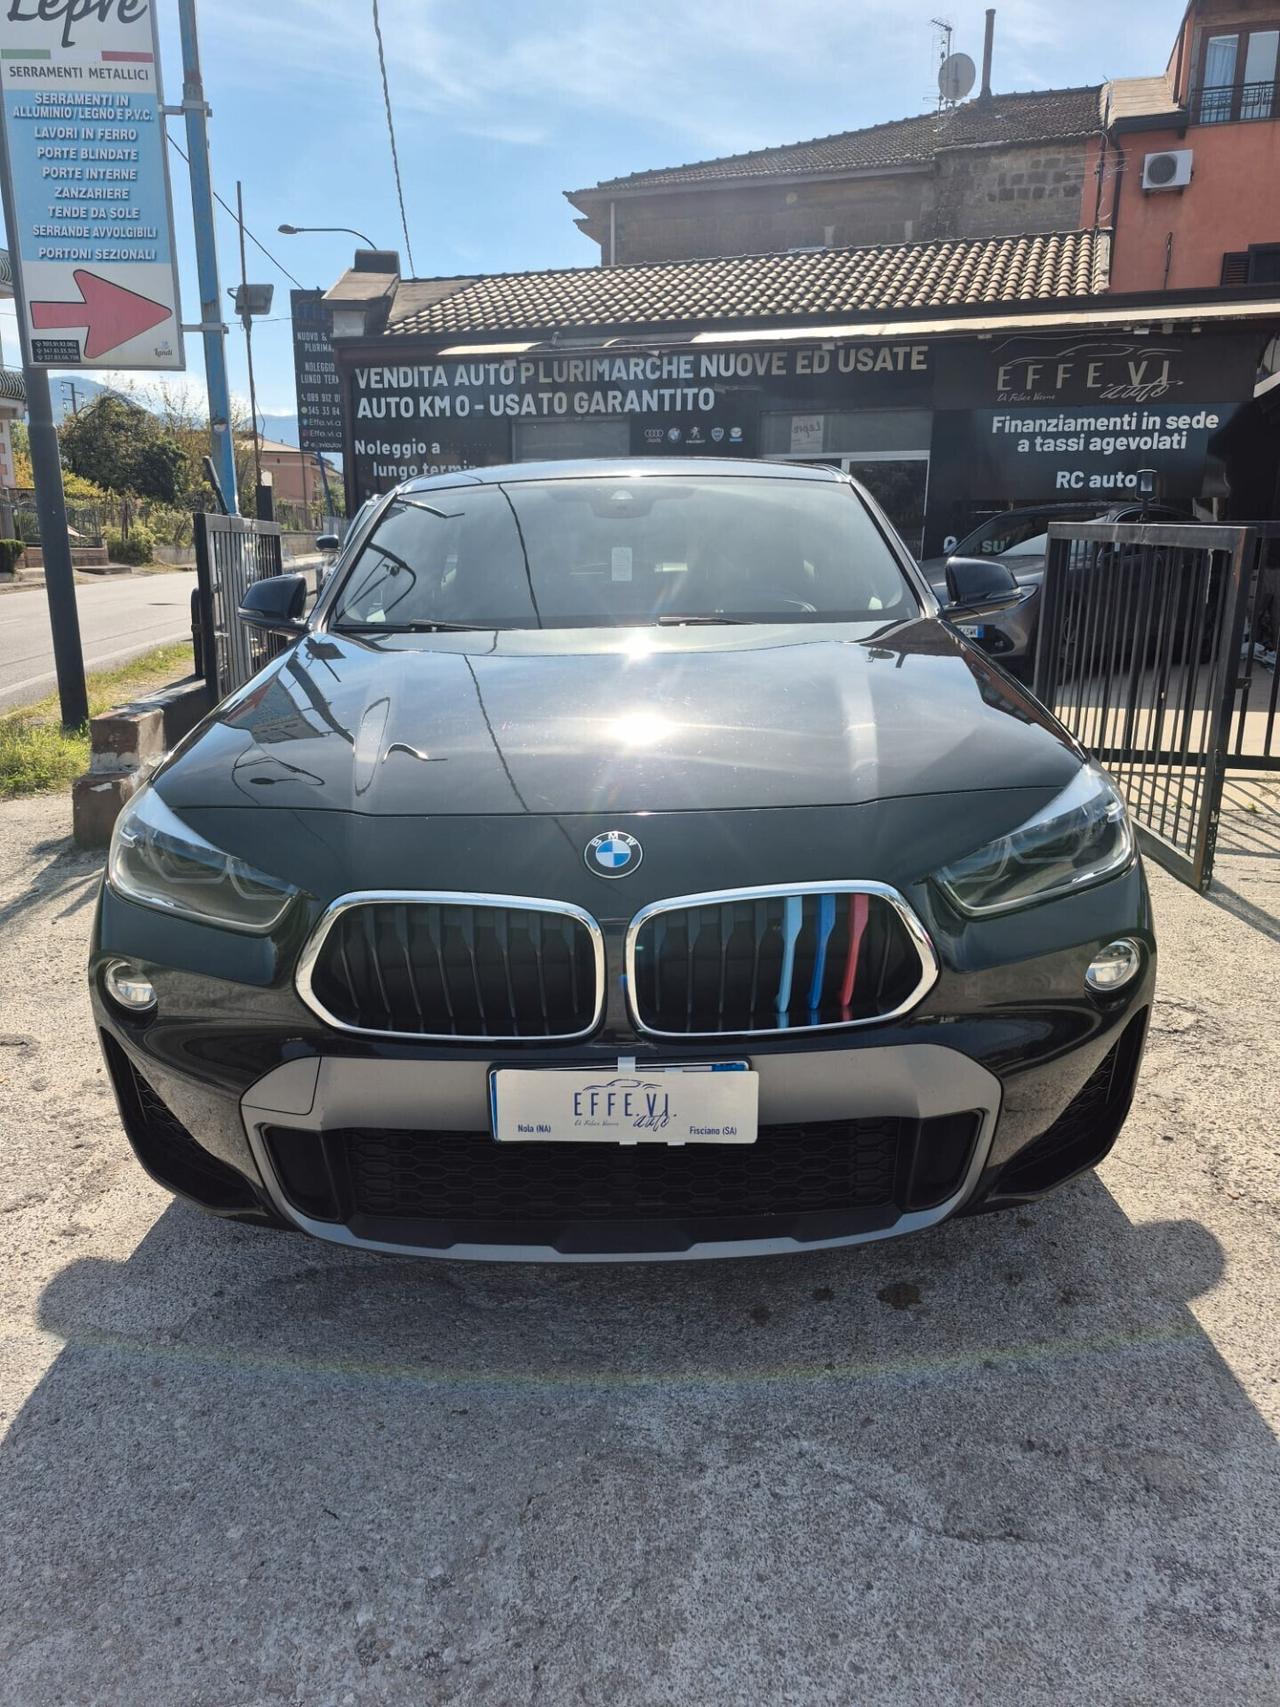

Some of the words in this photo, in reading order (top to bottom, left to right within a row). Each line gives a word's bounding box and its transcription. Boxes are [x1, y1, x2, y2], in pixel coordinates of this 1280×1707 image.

[9, 66, 83, 79] SERRAMENTI
[88, 68, 149, 81] METALLICI
[34, 92, 113, 106] SERRAMENTI
[116, 94, 129, 106] IN
[117, 109, 122, 121] E
[126, 109, 153, 121] P.V.C.
[34, 127, 78, 140] LAVORI
[81, 128, 94, 140] IN
[97, 128, 137, 141] FERRO
[37, 148, 77, 160] PORTE
[80, 149, 138, 161] BLINDATE
[42, 167, 83, 179] PORTE
[86, 168, 137, 181] INTERNE
[55, 186, 129, 199] ZANZARIERE
[48, 206, 87, 219] TENDE
[91, 207, 107, 219] DA
[110, 207, 140, 219] SOLE
[32, 224, 89, 238] SERRANDE
[92, 226, 157, 239] AVVOLGIBILI
[39, 247, 91, 260] PORTONI
[95, 248, 156, 261] SEZIONALI
[305, 362, 335, 372] NOLEGGIO
[355, 365, 449, 390] VENDITA
[454, 363, 516, 386] AUTO
[700, 351, 788, 378] NUOVE
[795, 350, 830, 375] ED
[838, 345, 928, 372] USATE
[301, 375, 322, 384] LUNGO
[357, 396, 415, 419] AUTO
[490, 392, 568, 416] USATO
[573, 387, 715, 415] GARANTITO
[992, 413, 1137, 434] Finanziamenti
[1142, 412, 1161, 430] in
[1166, 410, 1219, 429] sede
[355, 438, 426, 458] Noleggio
[431, 442, 441, 454] a
[1017, 437, 1029, 452] a
[1035, 433, 1085, 452] tassi
[1089, 431, 1187, 455] agevolati
[373, 461, 417, 479] lungo
[1056, 471, 1084, 489] RC
[1088, 470, 1137, 488] auto
[590, 831, 637, 847] BMW
[518, 1124, 534, 1133] Nola
[535, 1125, 551, 1134] (NA)
[689, 1126, 720, 1136] Fisciano
[722, 1126, 737, 1136] (SA)
